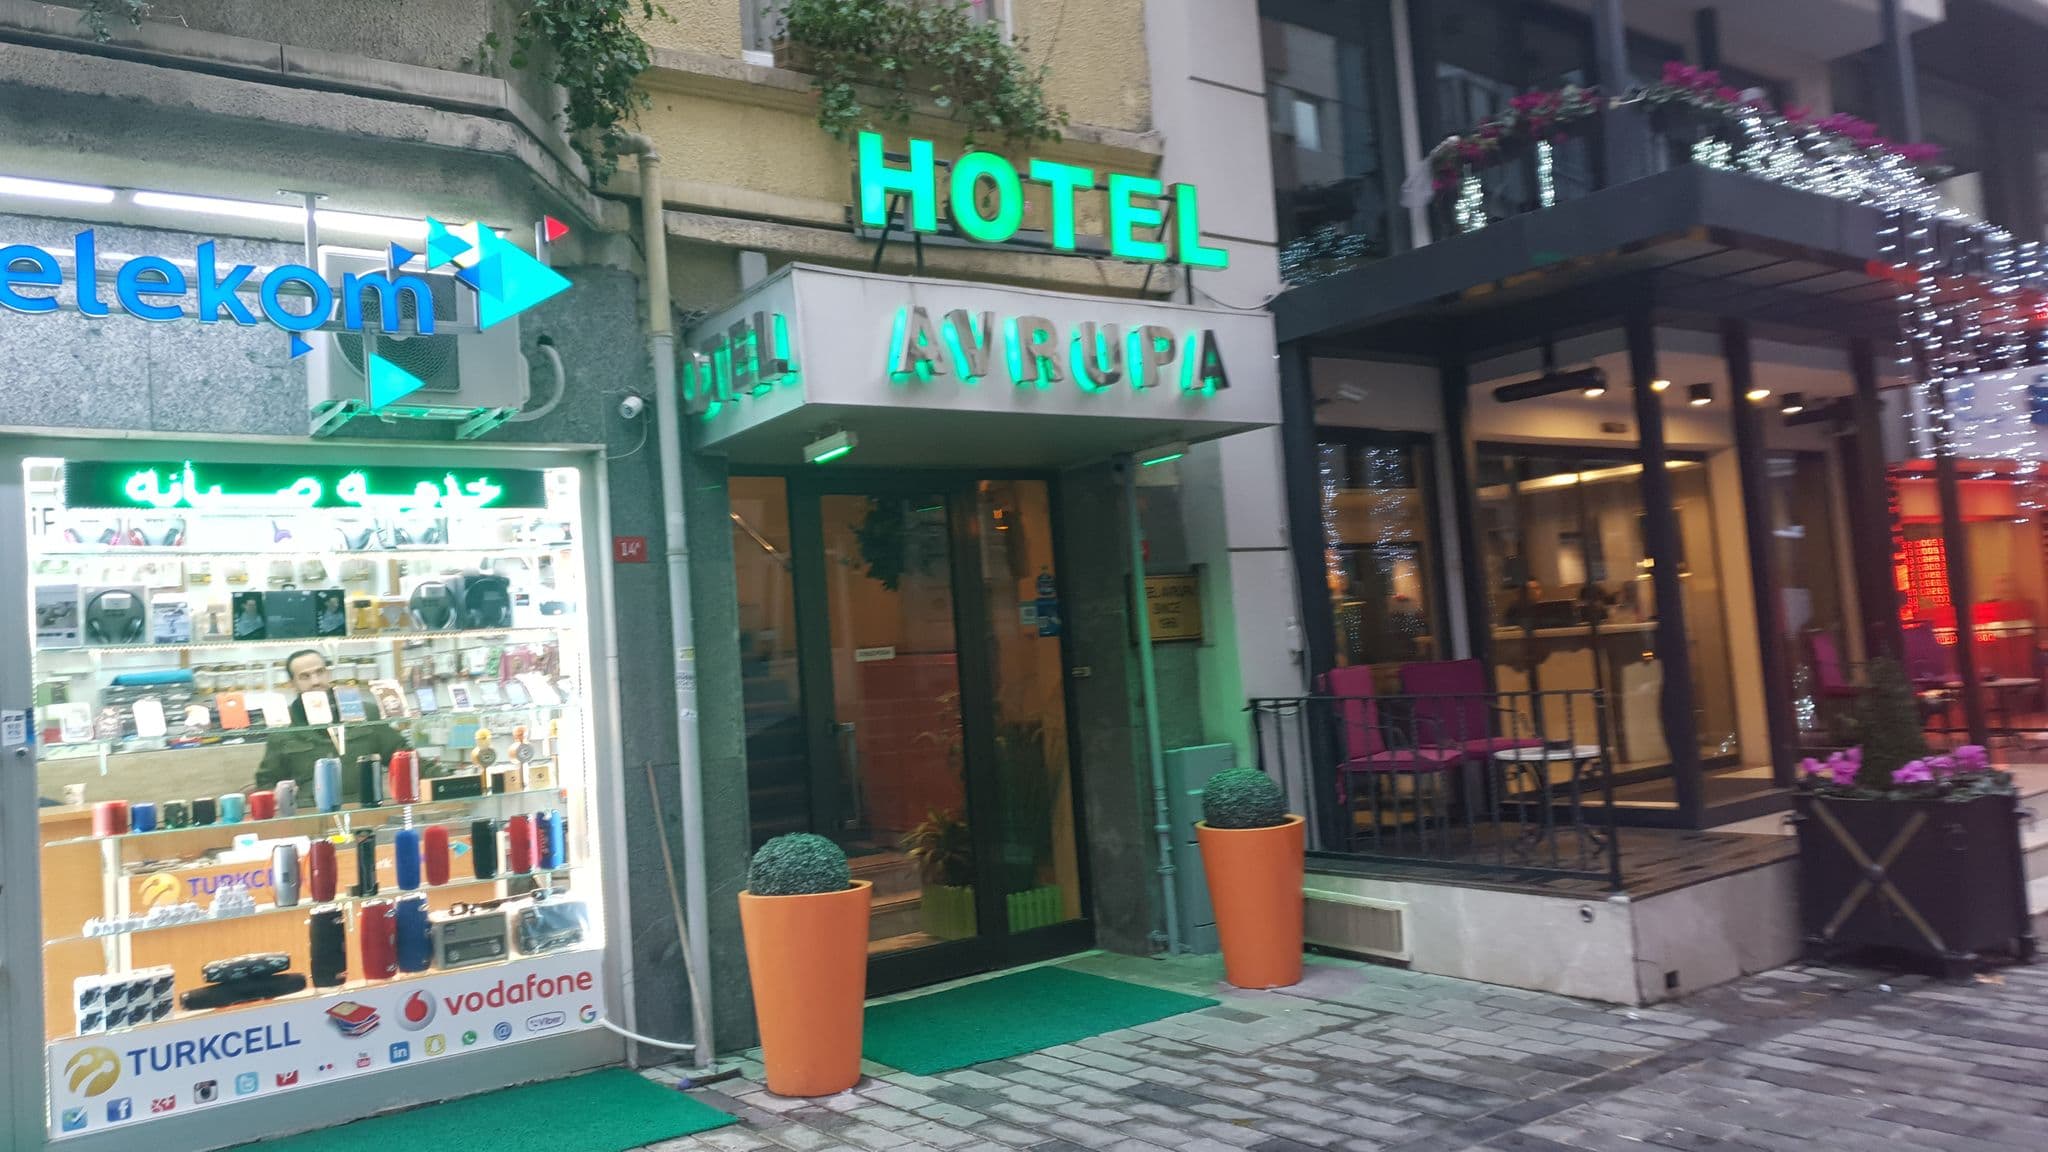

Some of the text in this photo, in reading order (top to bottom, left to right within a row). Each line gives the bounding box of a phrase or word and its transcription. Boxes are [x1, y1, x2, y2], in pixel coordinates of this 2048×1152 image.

[858, 131, 1229, 270] HOTEL
[0, 229, 436, 334] elekom
[888, 304, 1231, 392] AVRUPA
[187, 866, 274, 898] TURKC
[444, 971, 593, 1016] vodafone
[127, 1021, 302, 1077] TURKCELL
